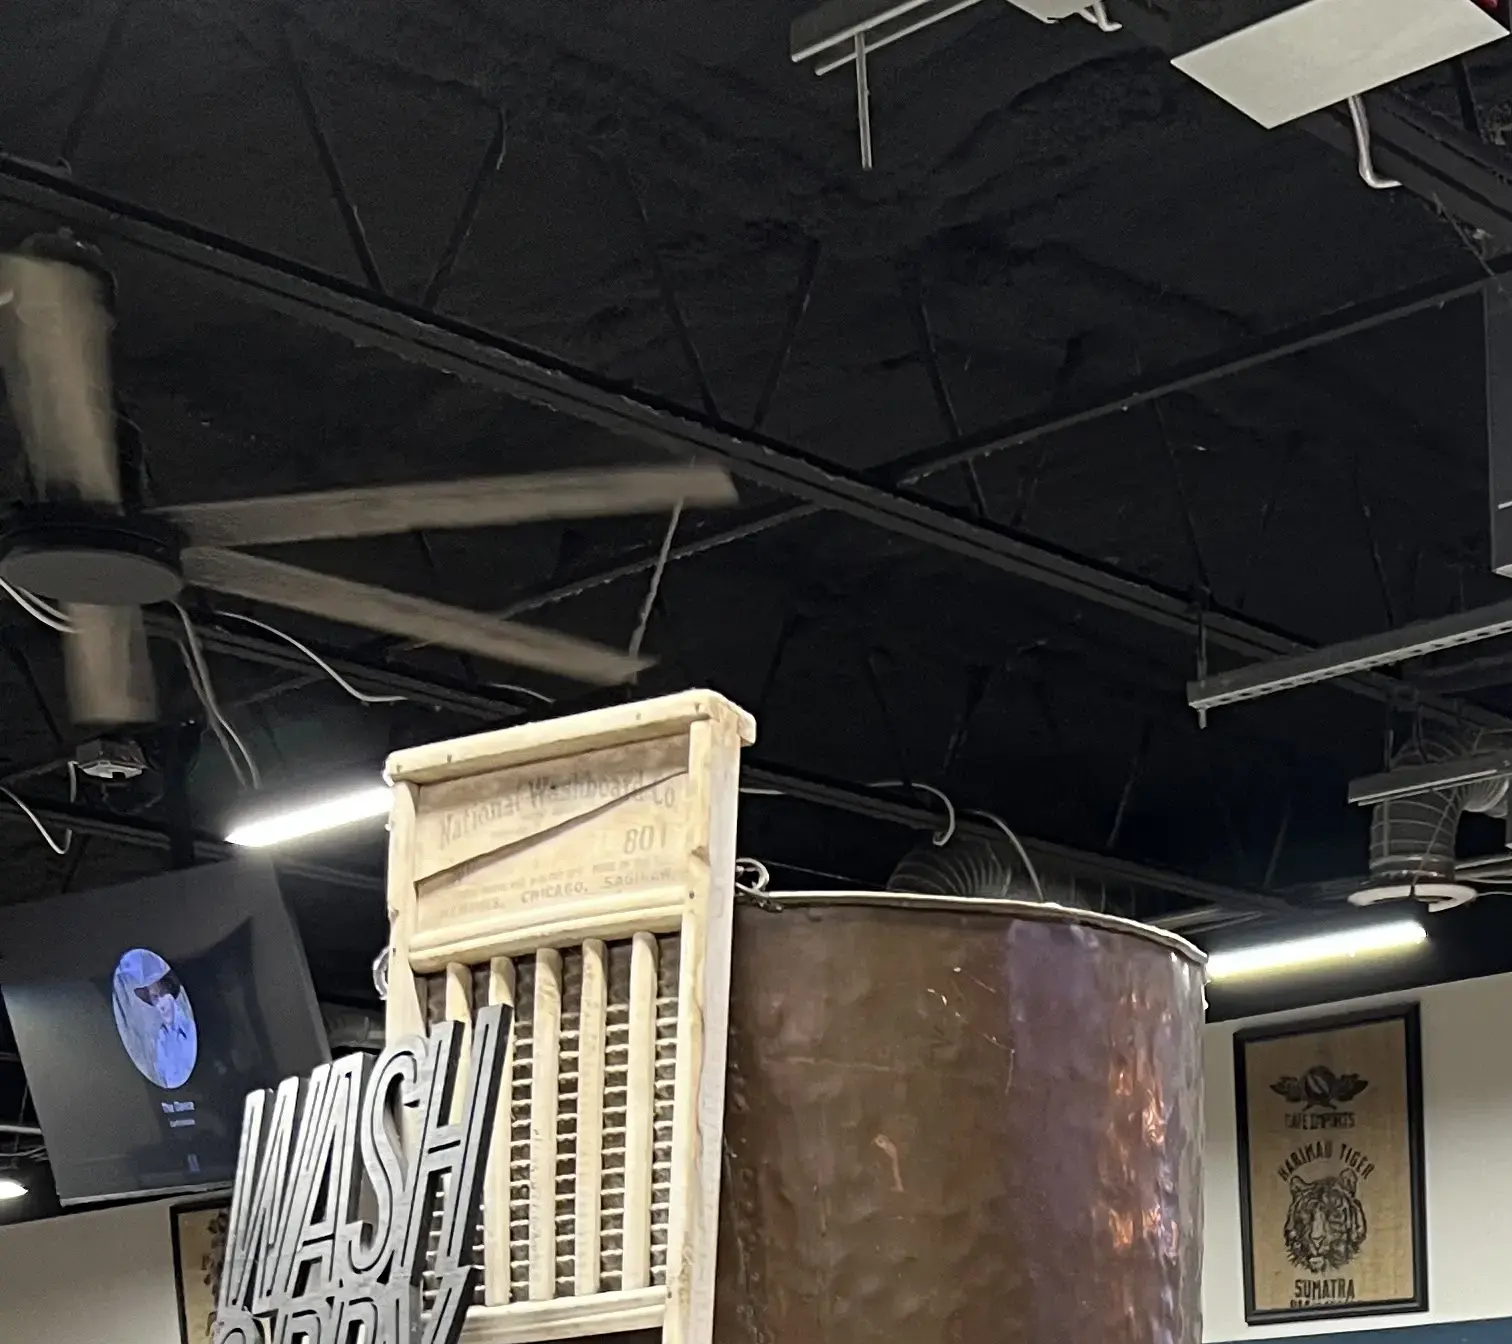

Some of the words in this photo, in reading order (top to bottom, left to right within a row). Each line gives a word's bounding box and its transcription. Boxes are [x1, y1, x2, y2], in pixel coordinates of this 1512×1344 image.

[624, 826, 667, 855] 801
[220, 1002, 514, 1322] WASH
[1278, 1141, 1332, 1181] HARIMAU
[1340, 1143, 1374, 1180] TIGER
[1294, 1279, 1355, 1300] SUMATRA
